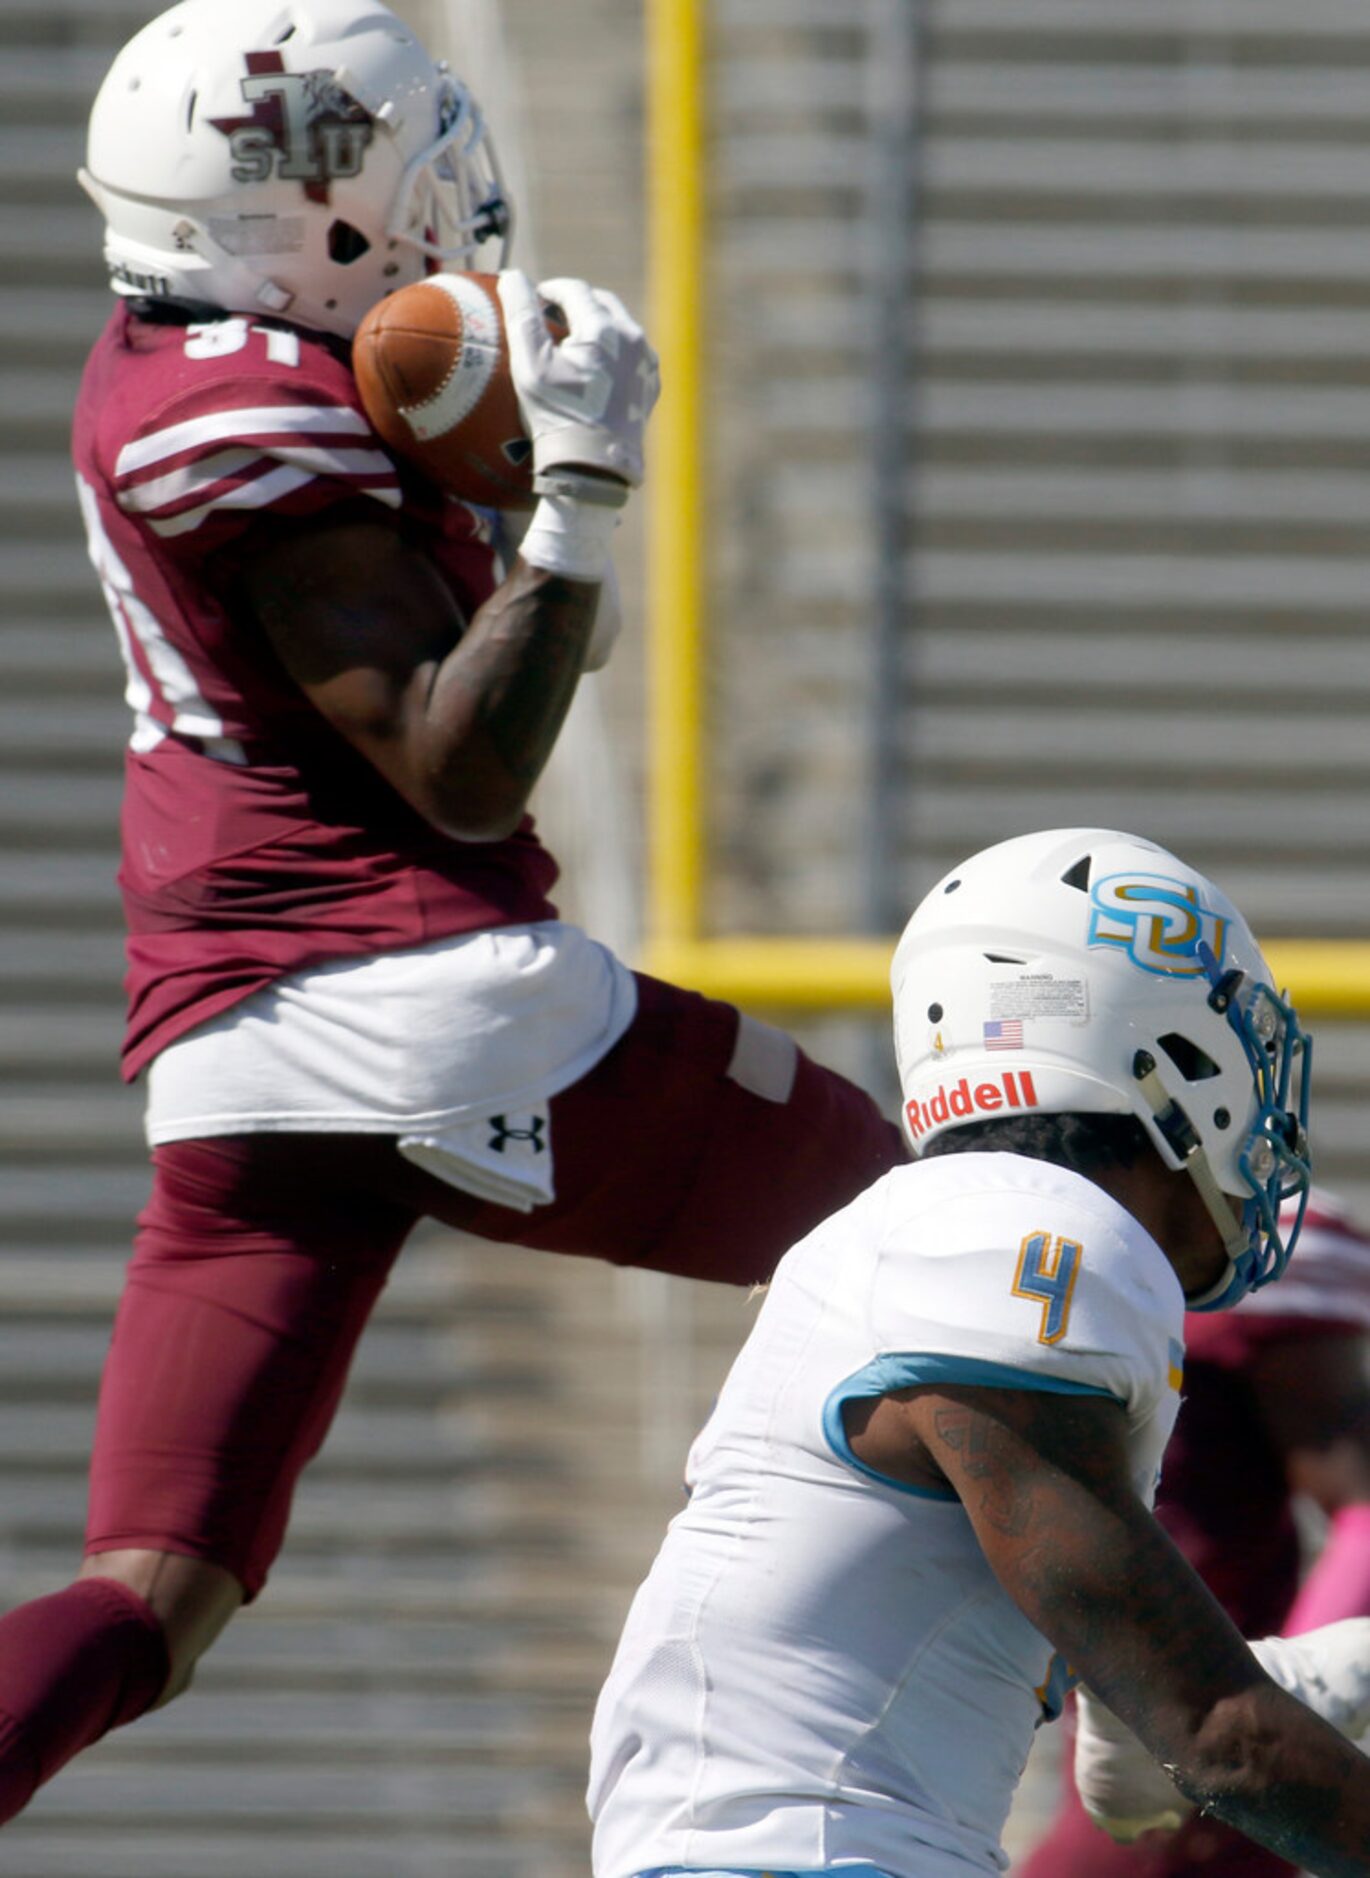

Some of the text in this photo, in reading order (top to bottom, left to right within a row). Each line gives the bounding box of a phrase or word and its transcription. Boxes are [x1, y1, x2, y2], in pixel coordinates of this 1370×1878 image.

[1087, 872, 1232, 980] SU
[905, 1070, 1039, 1140] Riddell
[1010, 1230, 1083, 1345] 4
